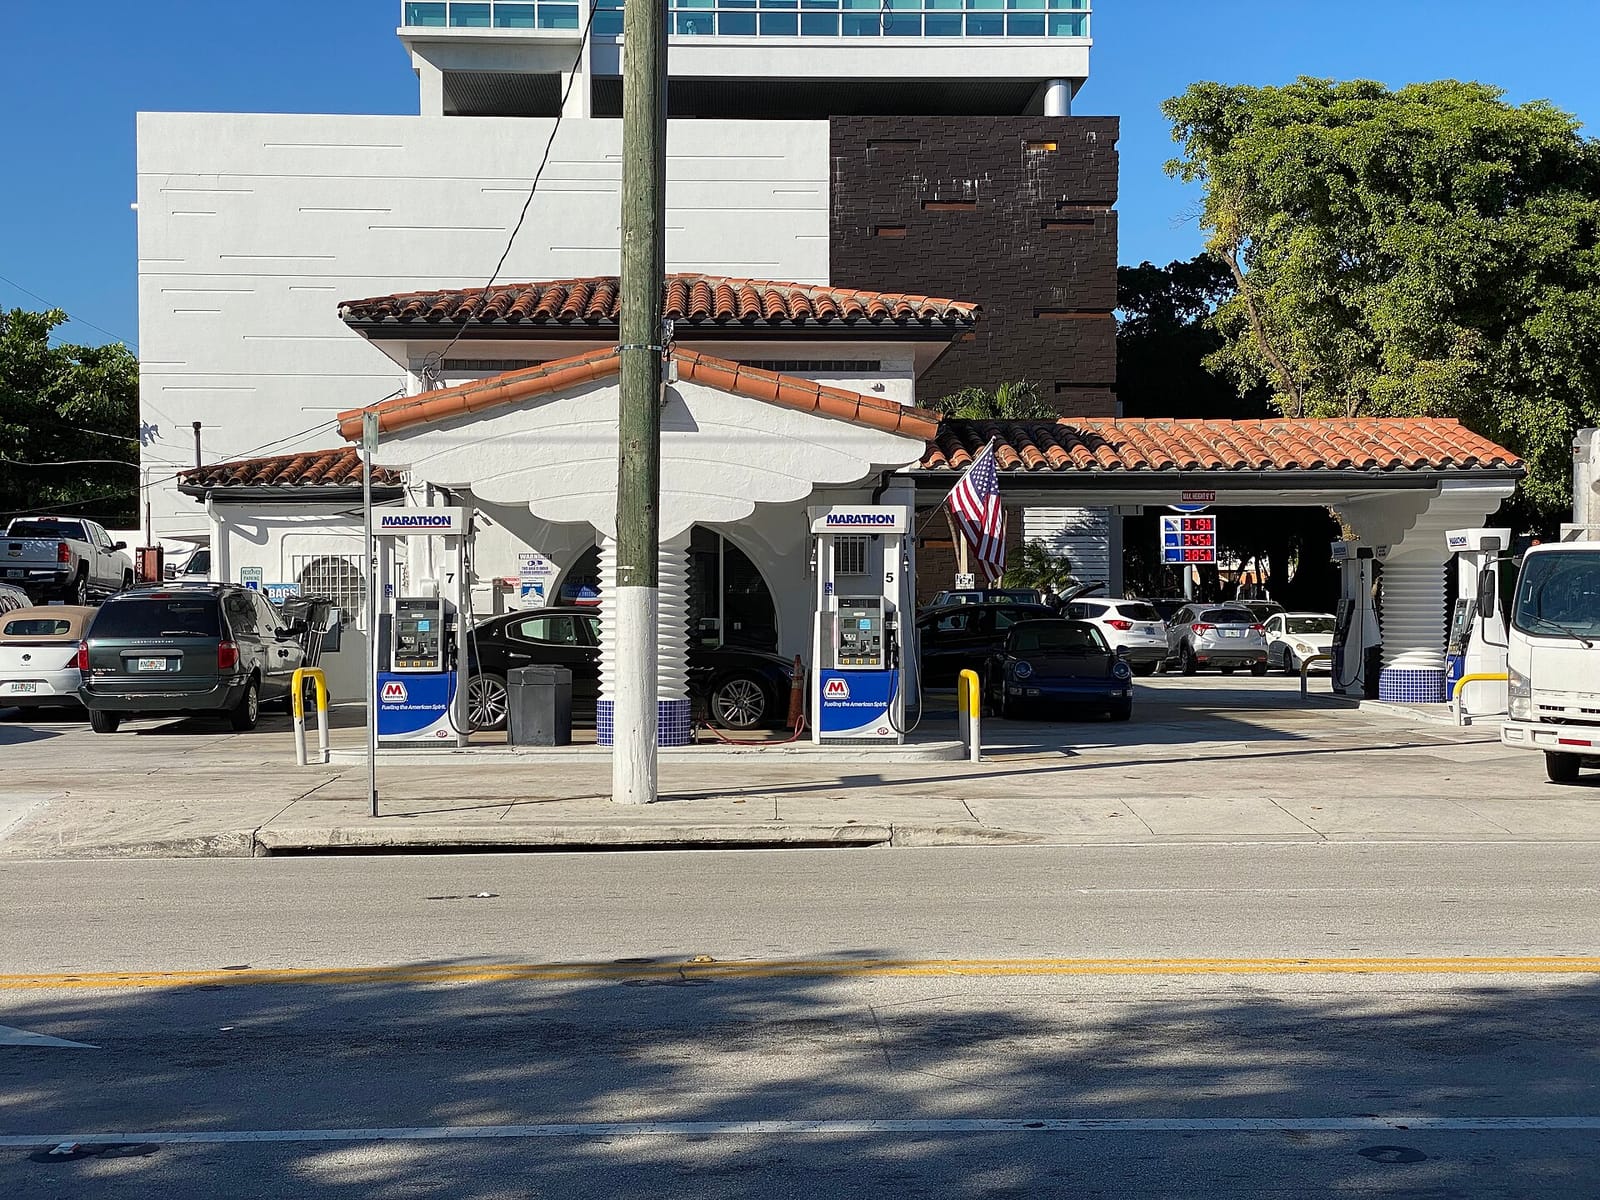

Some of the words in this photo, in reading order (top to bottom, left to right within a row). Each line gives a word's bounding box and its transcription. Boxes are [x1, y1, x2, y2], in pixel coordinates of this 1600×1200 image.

[382, 516, 451, 525] MARATHON
[827, 514, 894, 524] MARATHON
[446, 573, 454, 583] 7
[886, 572, 894, 583] 5
[268, 588, 296, 598] BAGS
